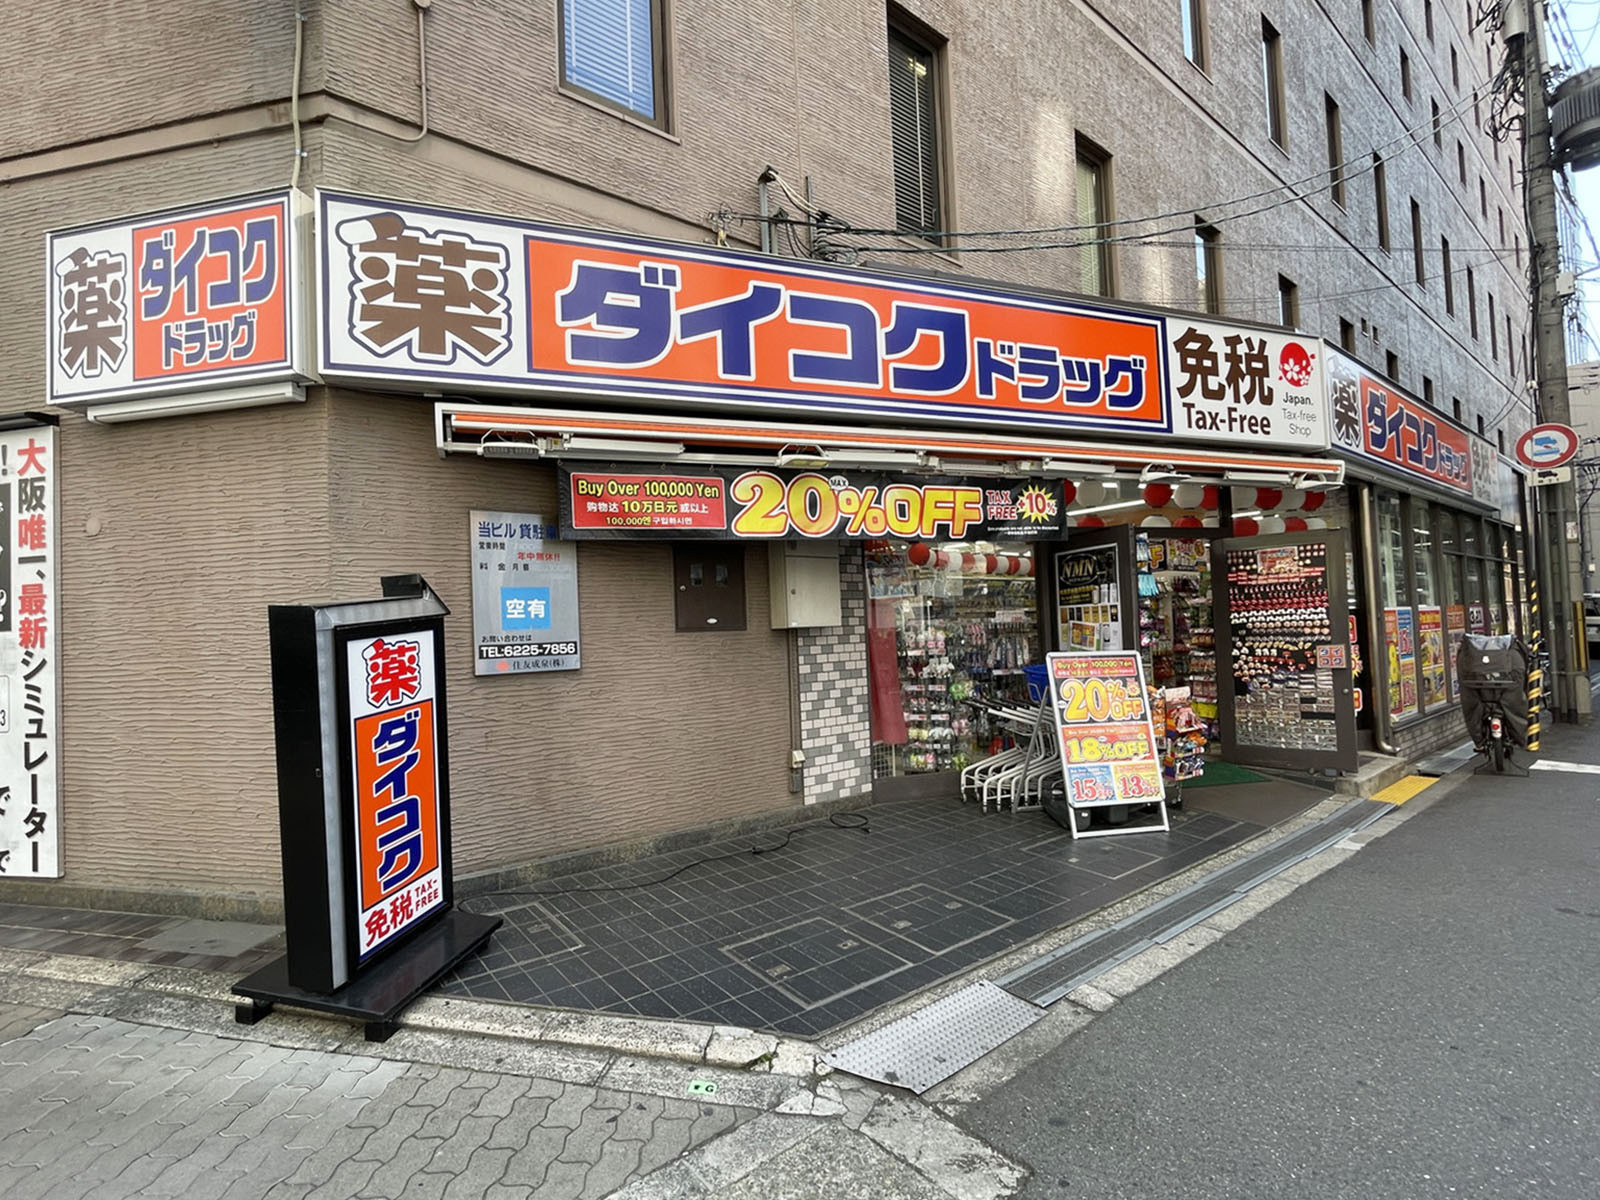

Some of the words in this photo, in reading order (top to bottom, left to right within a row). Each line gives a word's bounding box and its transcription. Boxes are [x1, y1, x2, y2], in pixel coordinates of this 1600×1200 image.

[141, 217, 277, 318] ダイコク
[356, 212, 503, 357] 薬
[60, 247, 123, 371] 薬
[164, 311, 256, 367] ドラッグ
[1173, 327, 1275, 407] 免税
[1182, 402, 1272, 436] Tax-Free
[1281, 407, 1318, 423] Tax-free
[1288, 420, 1312, 438] Shop
[577, 479, 604, 497] Buy
[607, 480, 640, 496] Over
[643, 481, 694, 498] 100,000
[695, 483, 720, 498] Yen
[986, 490, 1012, 505] TAX
[986, 504, 1019, 520] FREE
[478, 521, 516, 539] 当ビル
[1062, 558, 1095, 579] NMN
[505, 598, 546, 619] 空有
[368, 638, 419, 705] 薬
[1109, 698, 1145, 721] OFF
[373, 709, 423, 893] ダイコク
[415, 889, 439, 911] FREE
[364, 889, 414, 948] 免税
